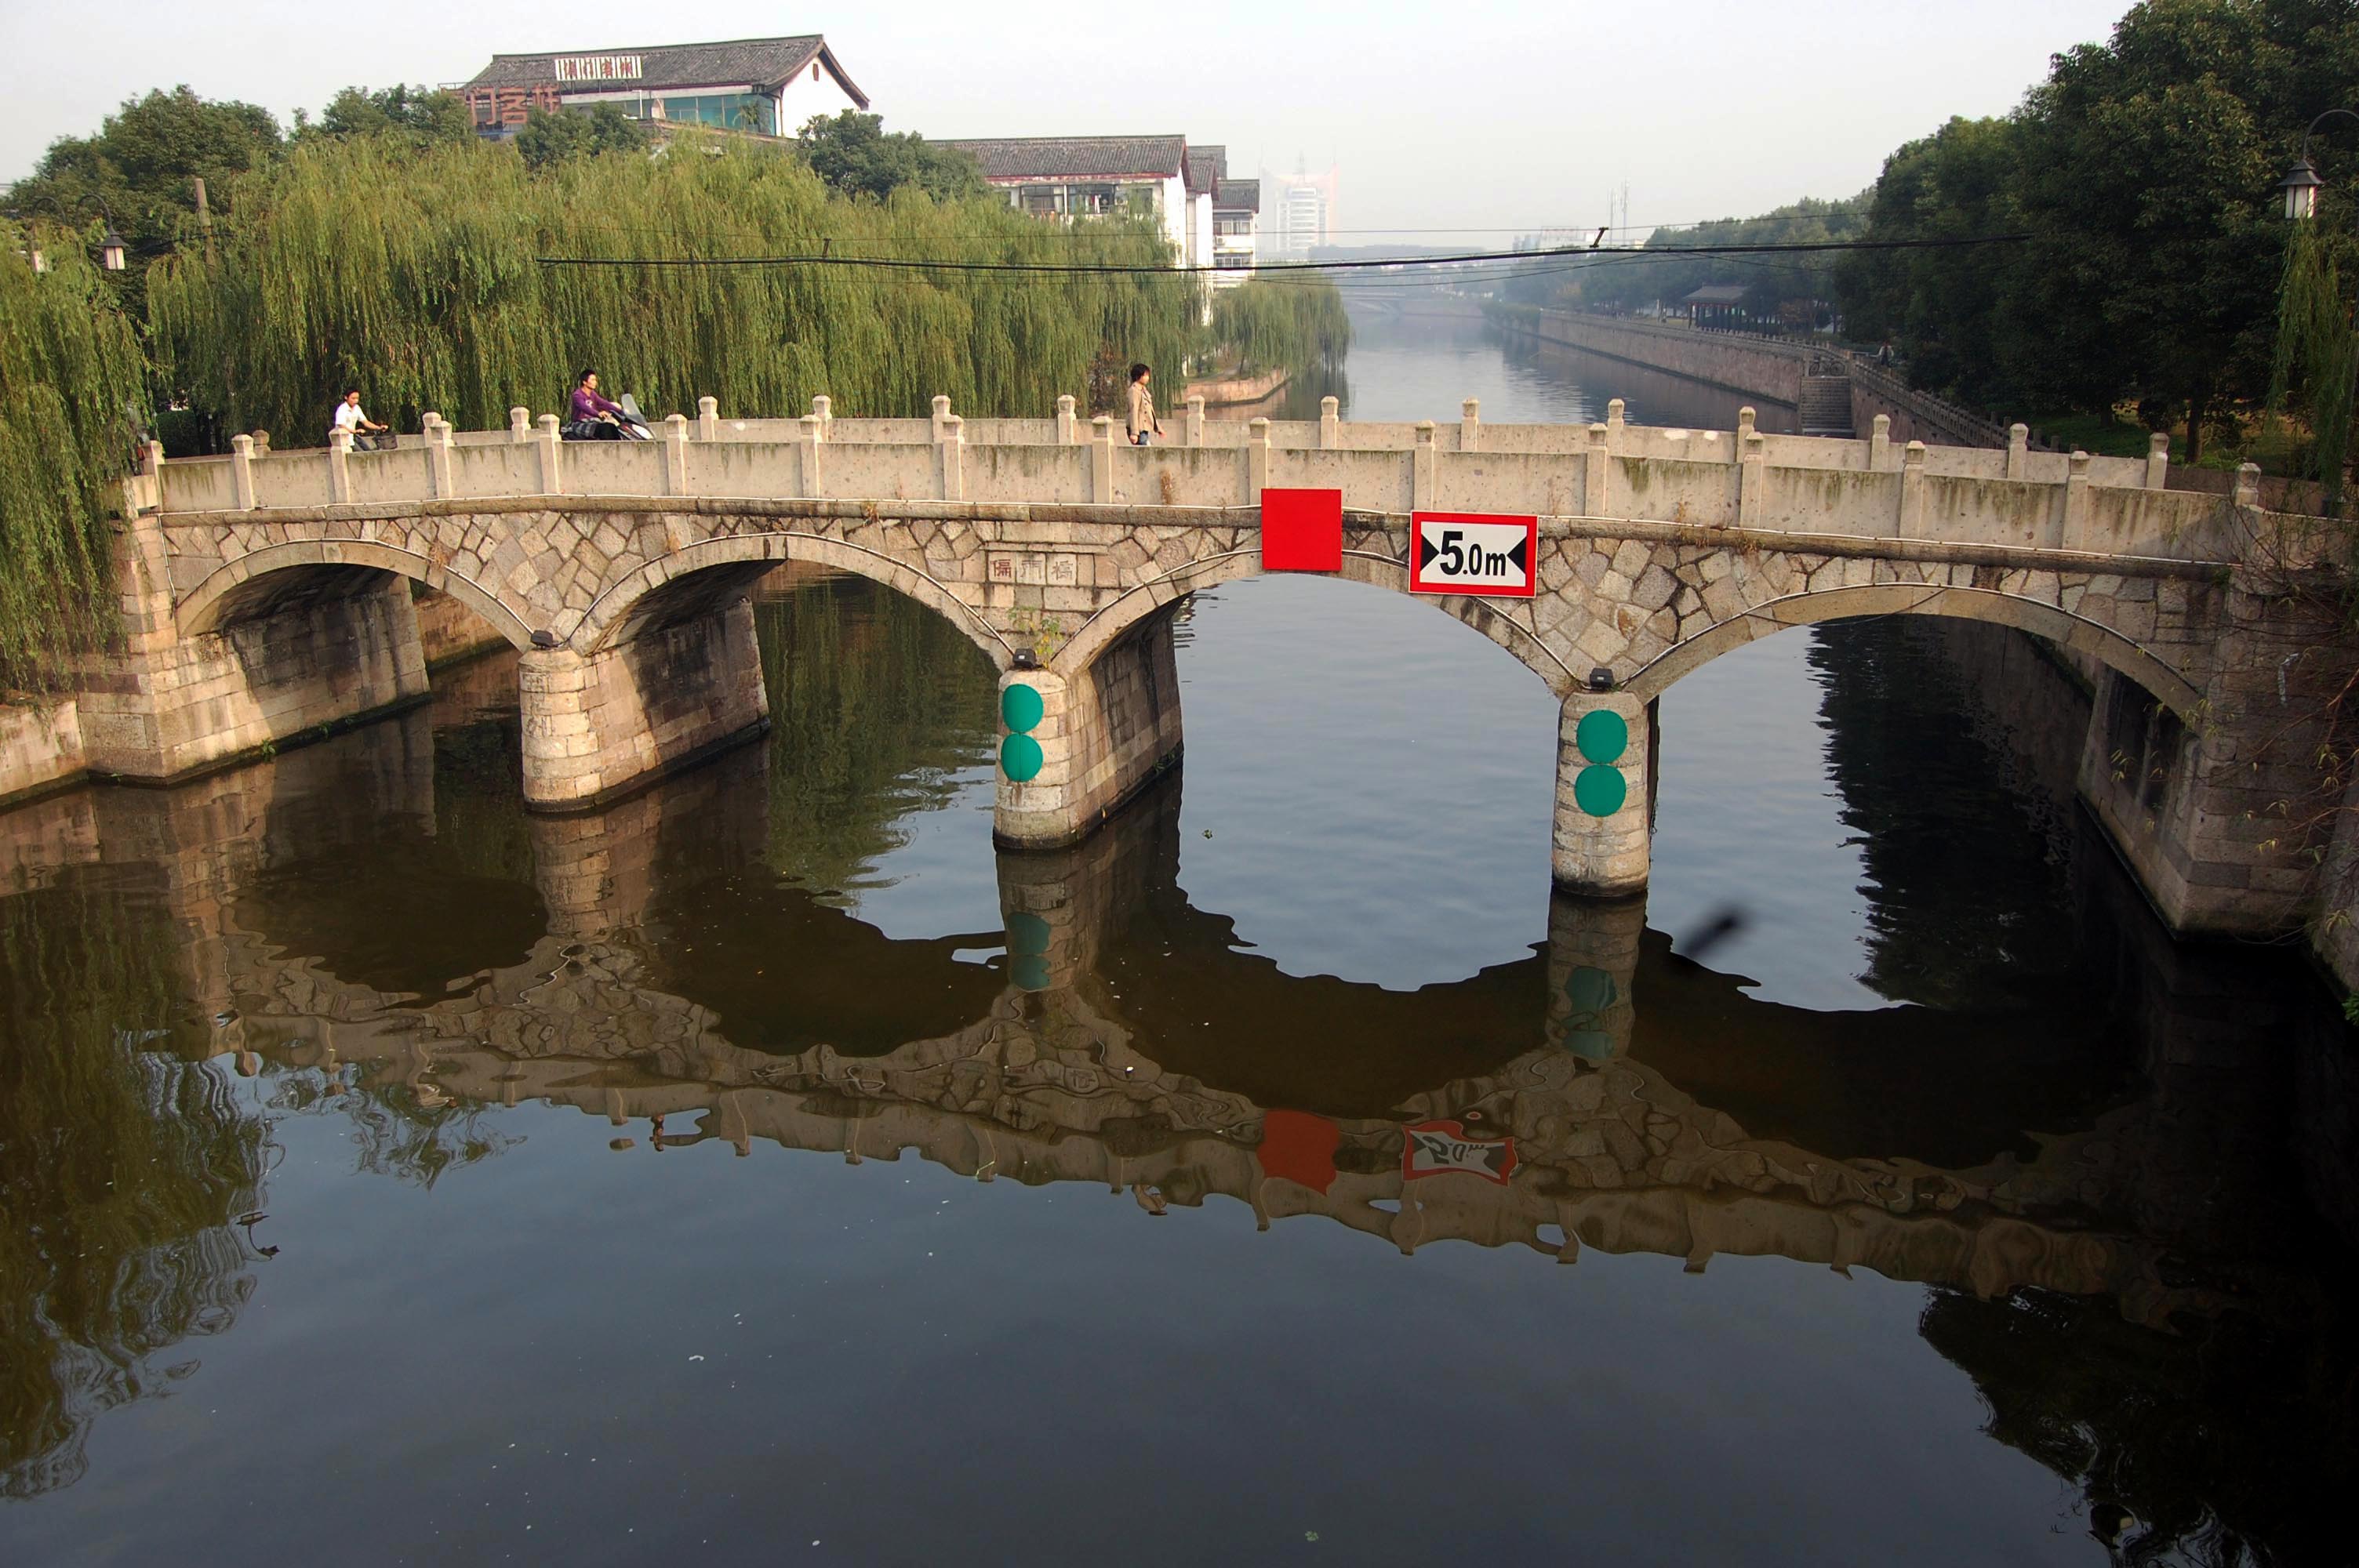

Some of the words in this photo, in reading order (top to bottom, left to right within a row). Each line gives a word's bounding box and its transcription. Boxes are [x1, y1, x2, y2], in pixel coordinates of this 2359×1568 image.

[440, 83, 560, 126] 门客栈
[1440, 531, 1507, 576] 5.0m
